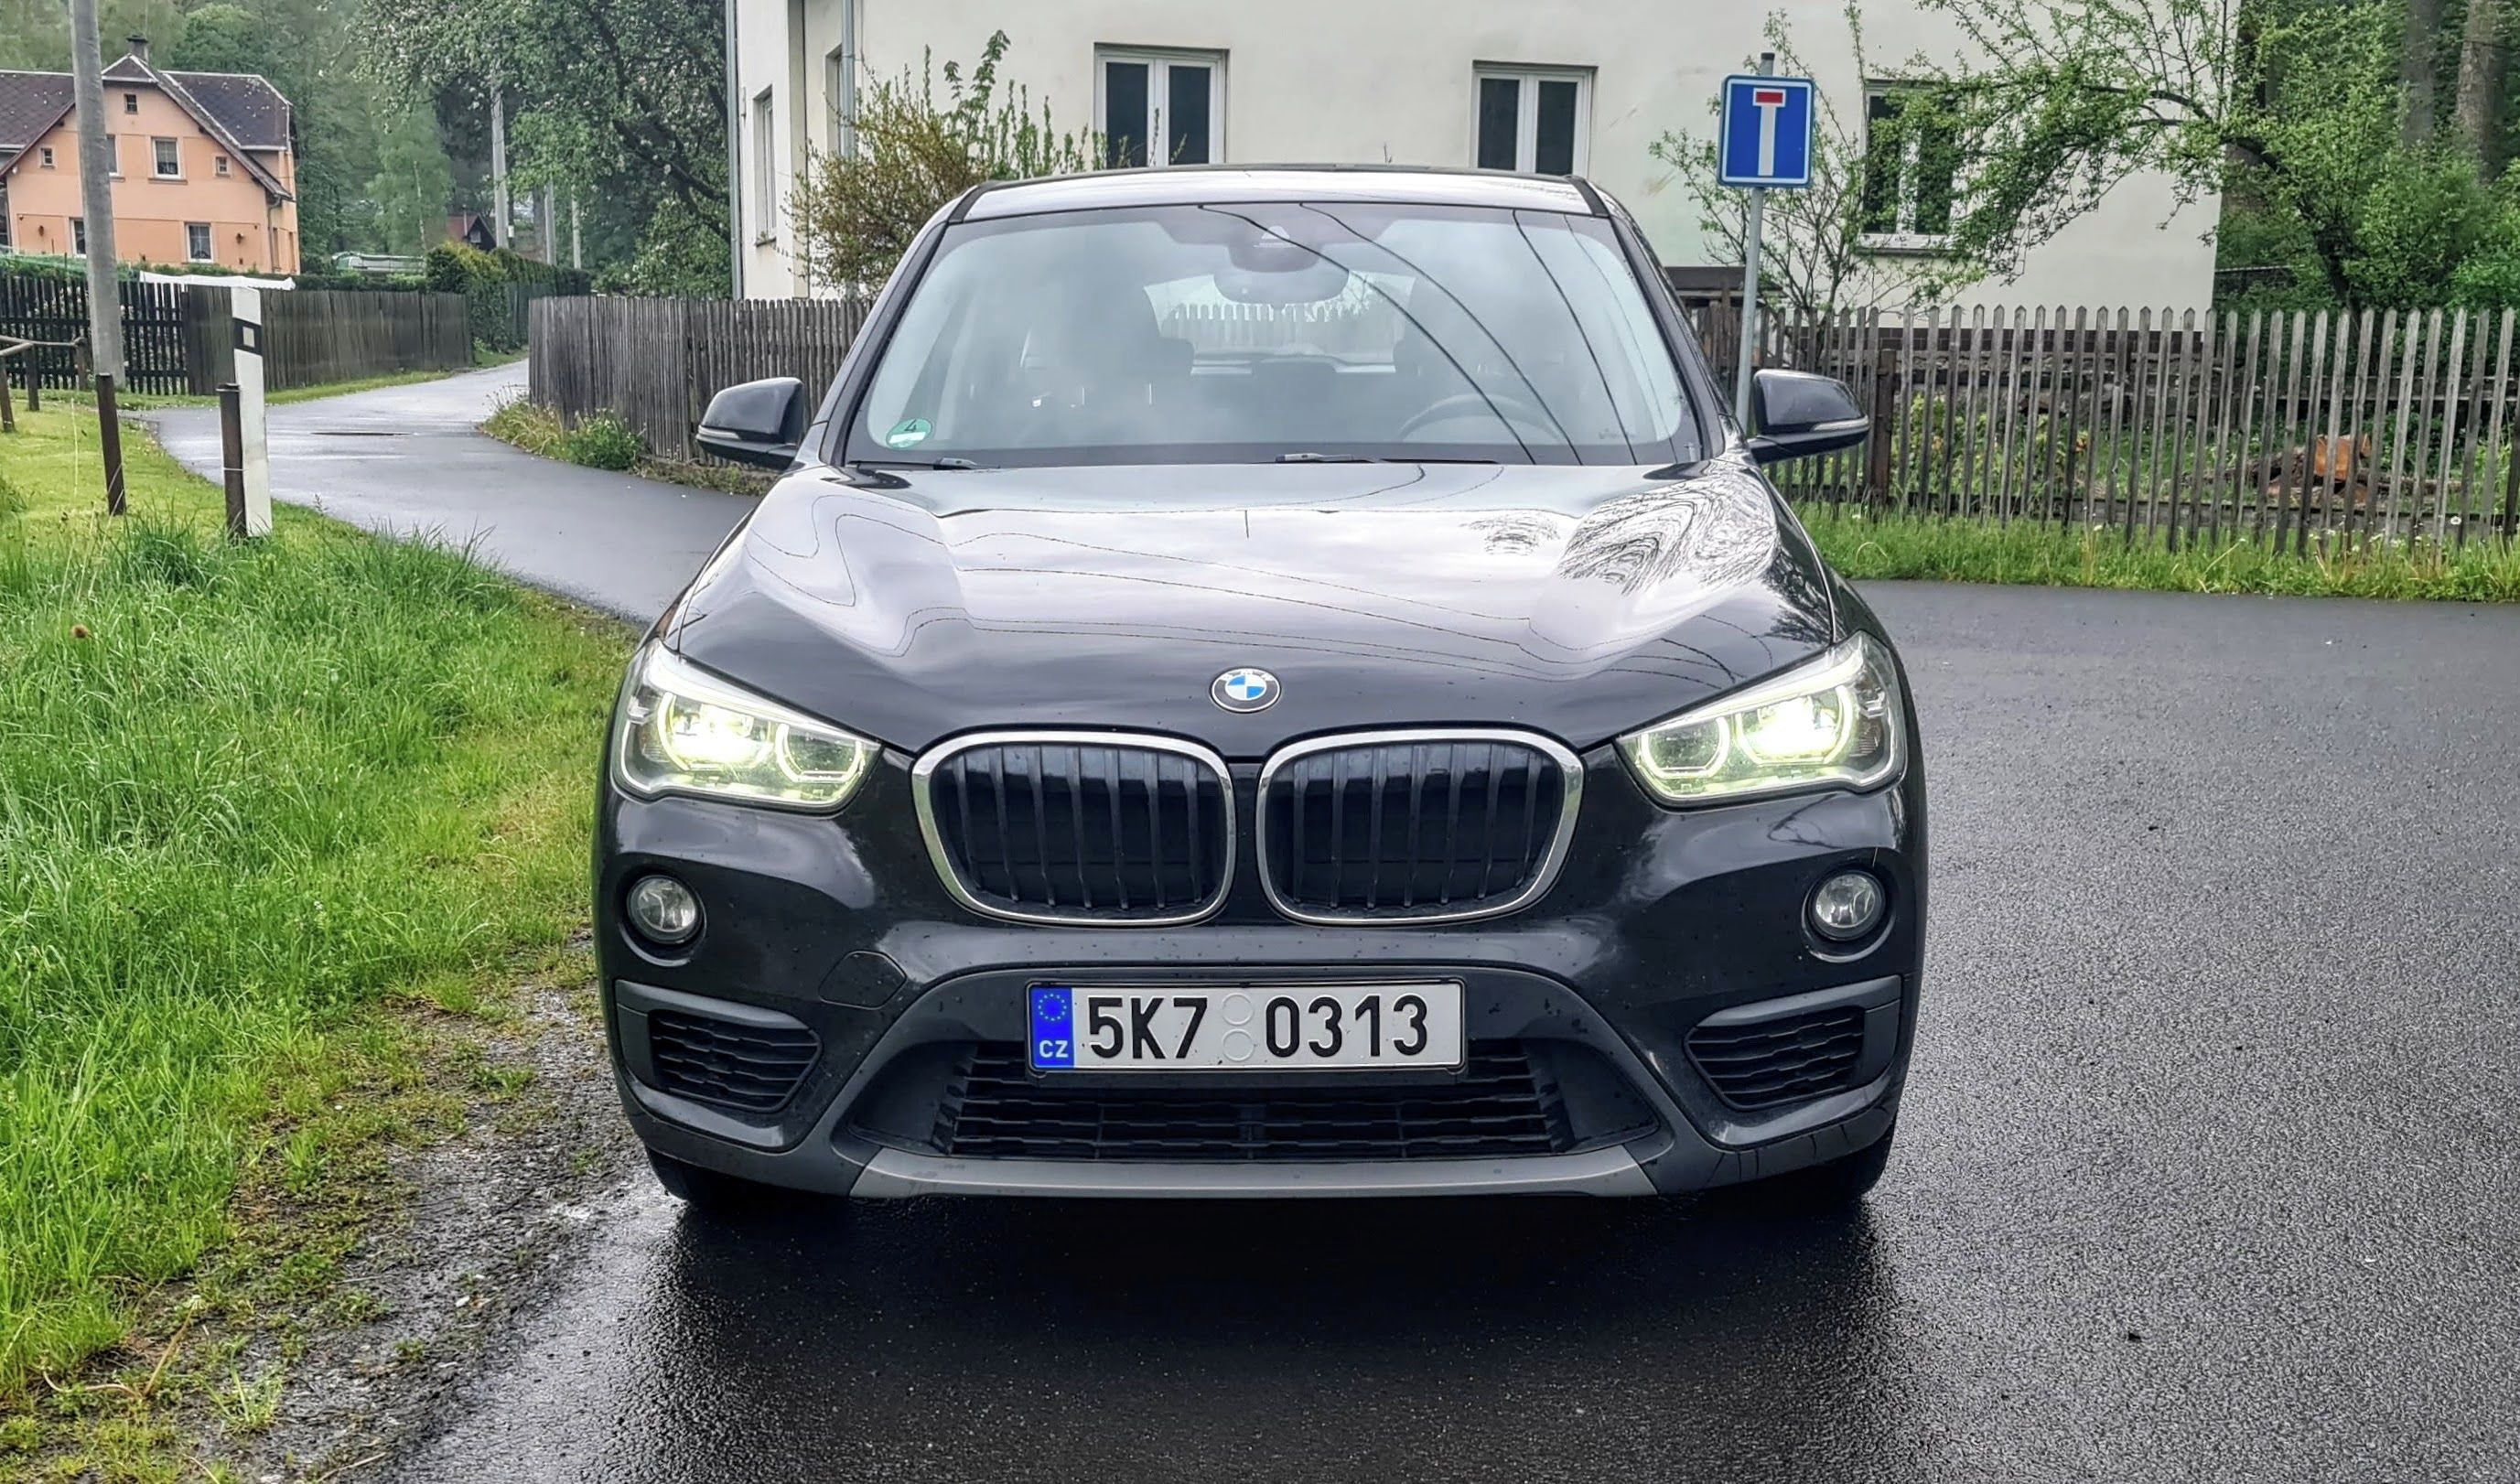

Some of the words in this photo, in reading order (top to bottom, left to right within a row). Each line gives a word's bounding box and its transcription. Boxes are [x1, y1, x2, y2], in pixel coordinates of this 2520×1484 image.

[1087, 996, 1209, 1059] 5K7
[1265, 995, 1428, 1058] 0313
[1039, 1039, 1069, 1059] CZ
